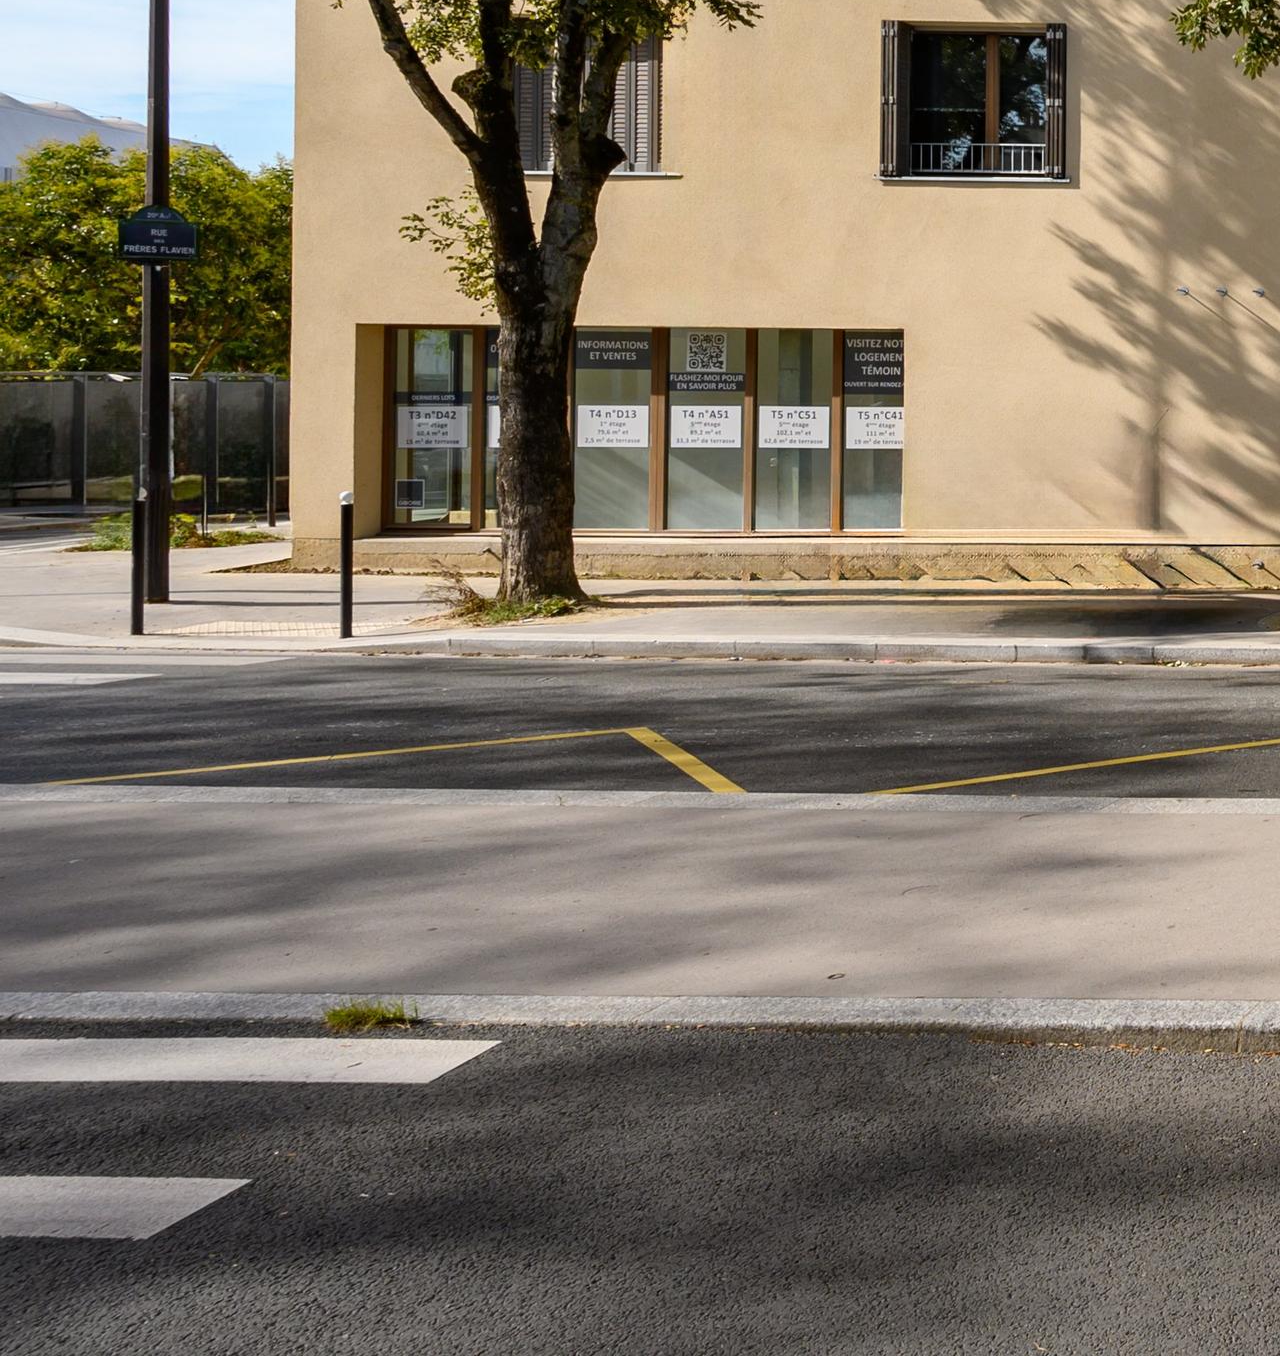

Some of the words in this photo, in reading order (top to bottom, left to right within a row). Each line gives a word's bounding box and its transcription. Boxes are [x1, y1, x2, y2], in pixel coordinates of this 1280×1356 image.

[150, 228, 168, 236] RUE
[160, 246, 195, 255] FLAVIEN
[578, 340, 649, 349] INFORMATIONS
[846, 339, 881, 348] VISITEZ
[884, 339, 904, 348] NOT
[590, 352, 600, 360] ET
[602, 352, 637, 360] VENTES
[855, 353, 904, 362] LOGEMEN
[861, 364, 901, 375] TÉMOIN
[408, 411, 421, 420] T3
[424, 411, 456, 420] n°D42
[589, 410, 601, 418] T4
[605, 410, 637, 418] n°D13
[681, 410, 694, 419] T4
[698, 410, 729, 419] n°A51
[771, 410, 783, 419] T5
[787, 410, 816, 419] n°C51
[857, 411, 870, 419] T5
[873, 411, 903, 419] n°C41
